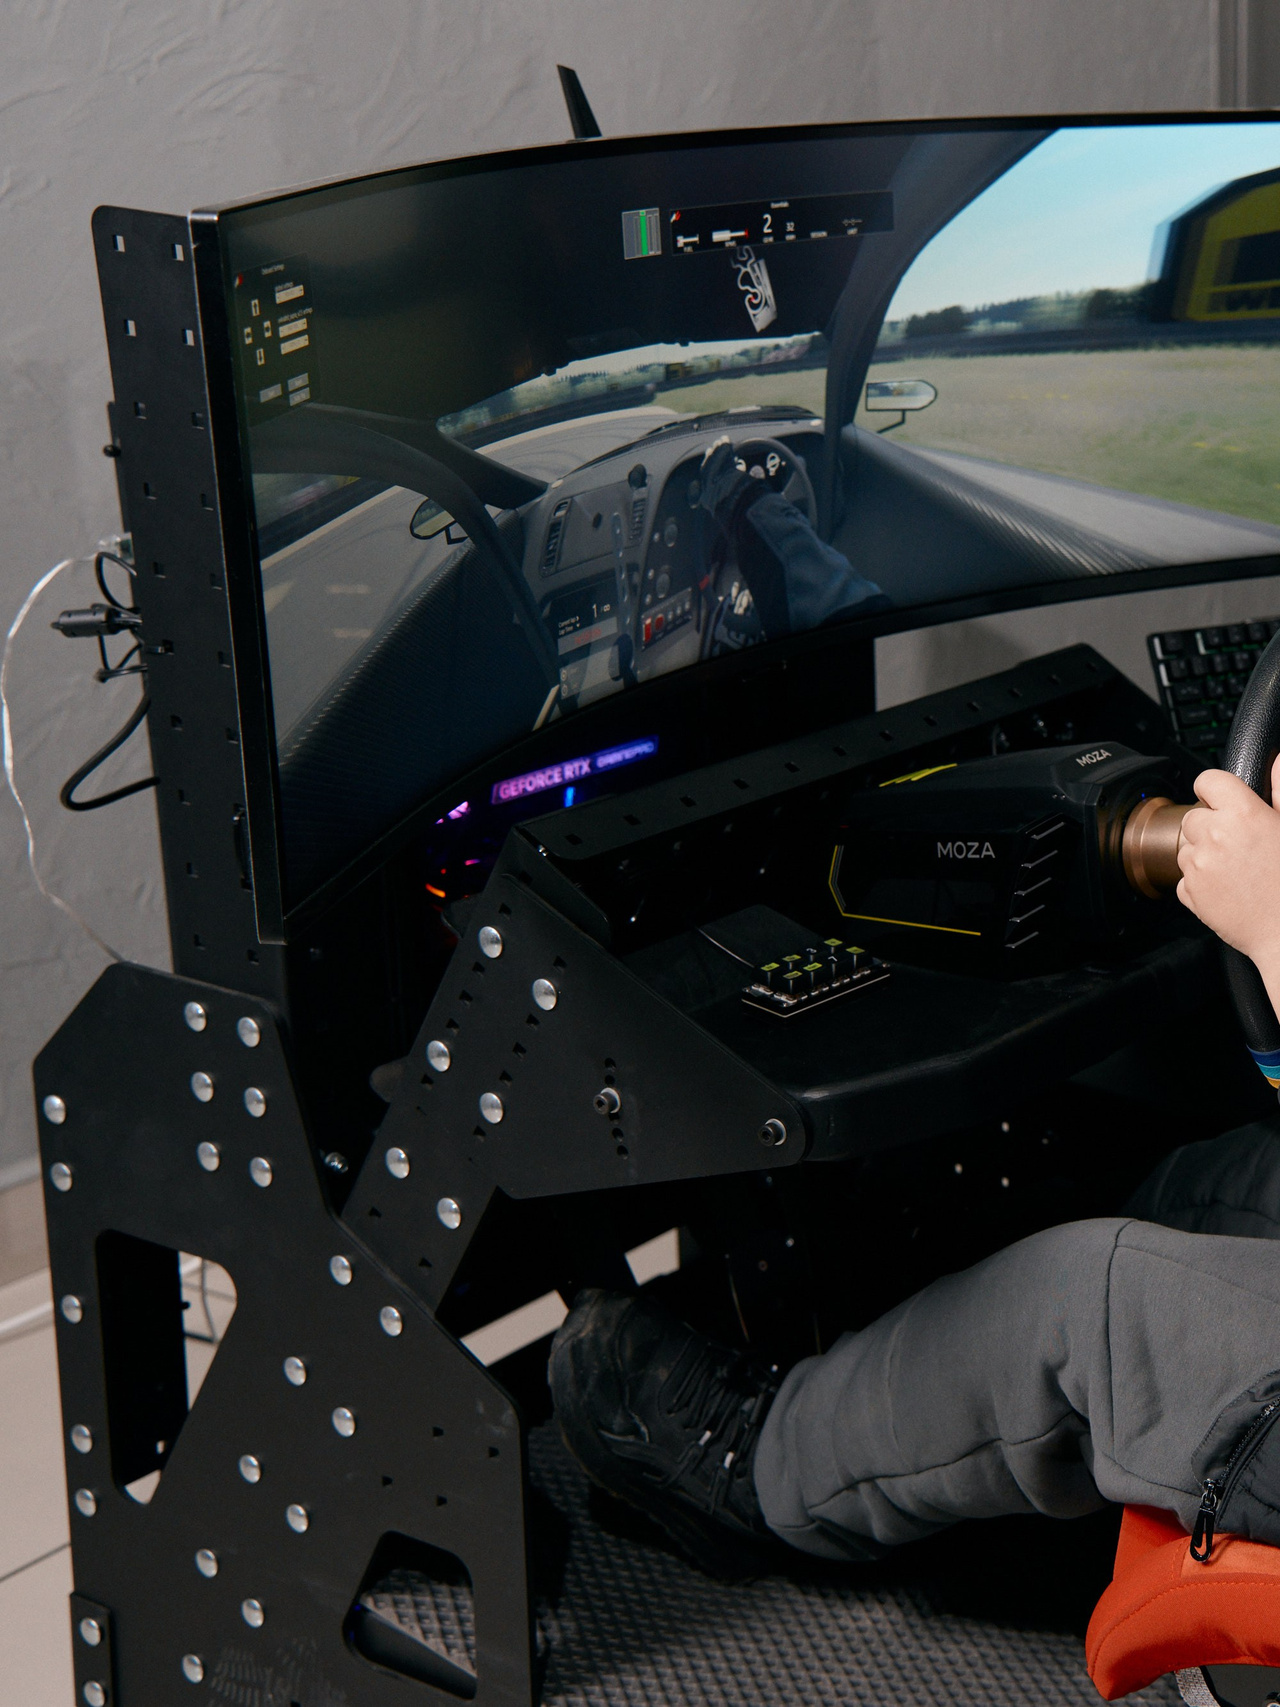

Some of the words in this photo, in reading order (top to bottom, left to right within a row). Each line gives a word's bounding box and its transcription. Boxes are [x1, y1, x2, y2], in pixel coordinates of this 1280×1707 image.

[763, 214, 772, 233] 2
[786, 222, 795, 232] 32
[1075, 749, 1112, 767] MOZA
[499, 767, 563, 800] GEFORCE
[564, 758, 592, 781] RTX
[937, 842, 996, 859] MOZA
